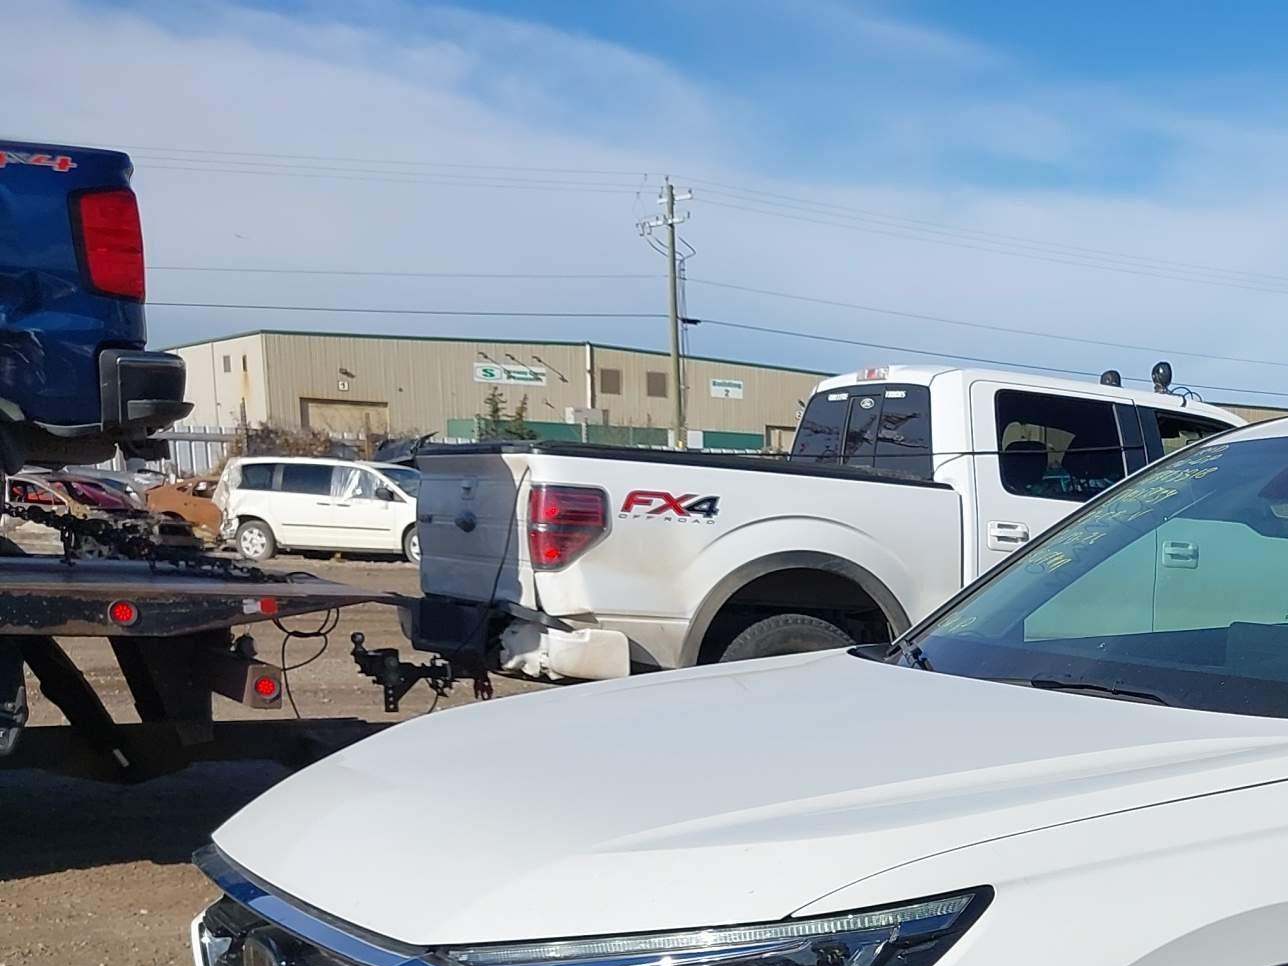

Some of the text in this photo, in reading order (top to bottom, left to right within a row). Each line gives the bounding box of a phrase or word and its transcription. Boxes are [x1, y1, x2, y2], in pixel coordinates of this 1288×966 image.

[0, 151, 77, 172] X4
[620, 489, 721, 519] FX4
[663, 516, 715, 525] ROAD
